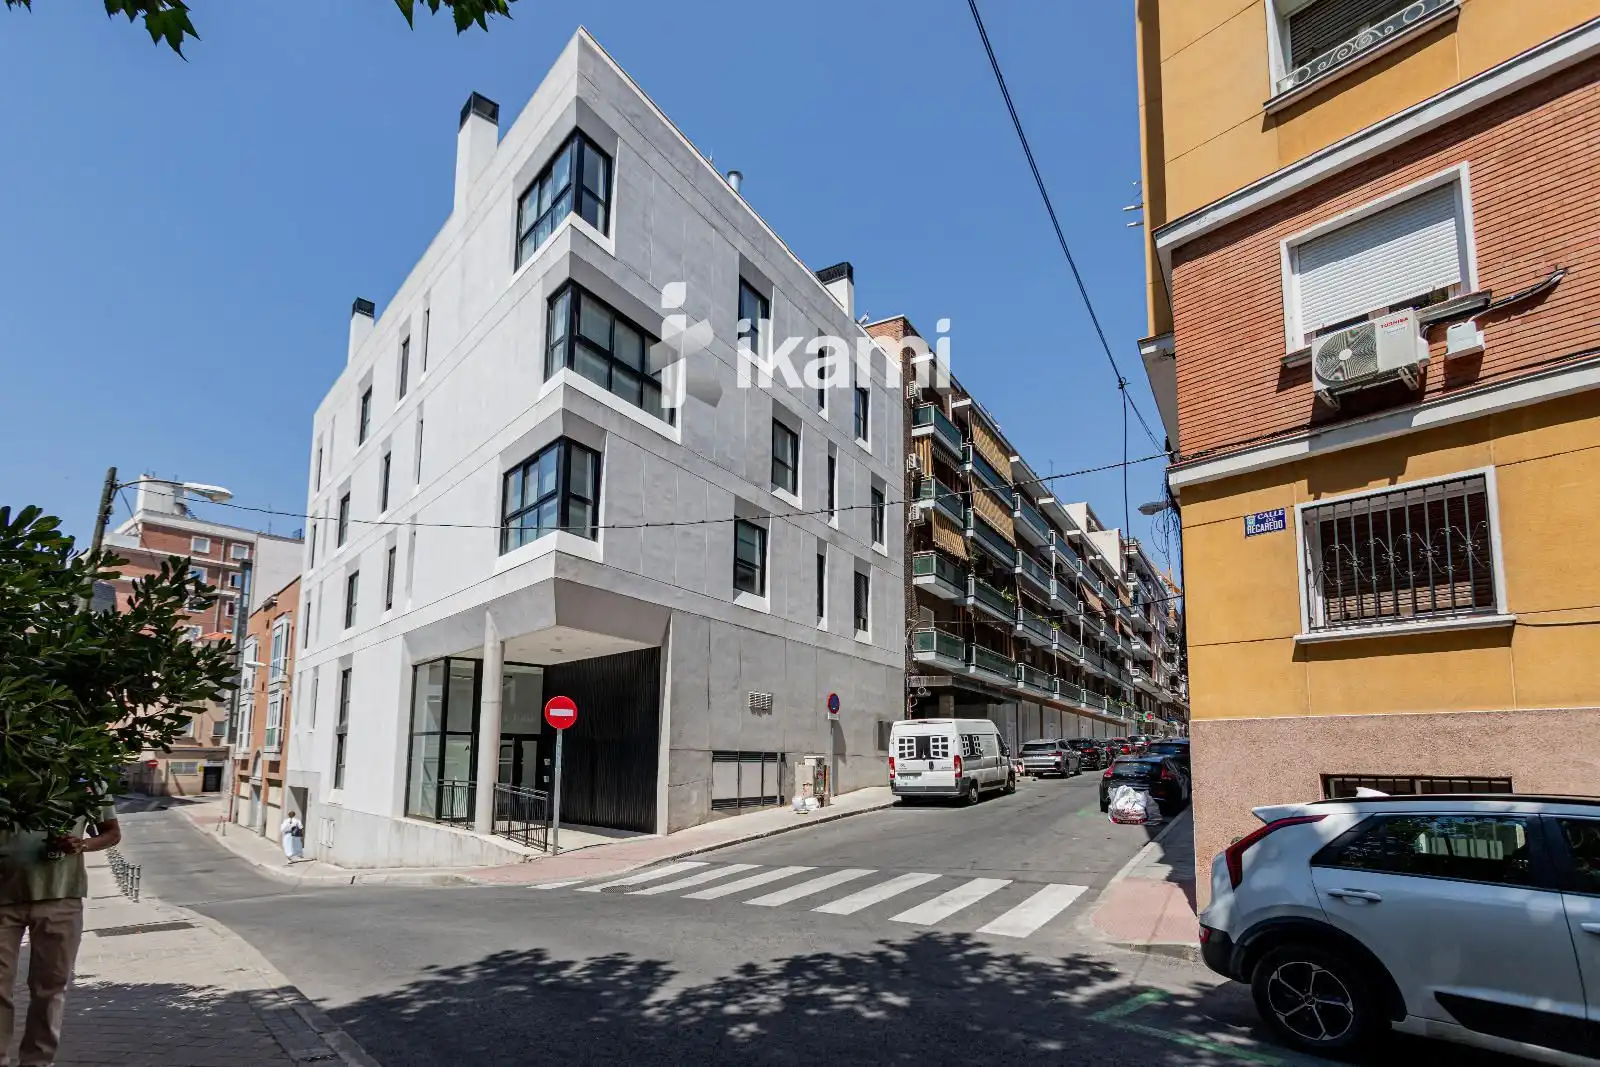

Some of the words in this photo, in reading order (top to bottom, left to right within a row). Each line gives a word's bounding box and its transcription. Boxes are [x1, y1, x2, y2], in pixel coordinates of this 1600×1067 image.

[1380, 316, 1409, 328] TOSHIBA
[1257, 509, 1284, 520] CALLE
[1247, 519, 1283, 535] RECAREDO
